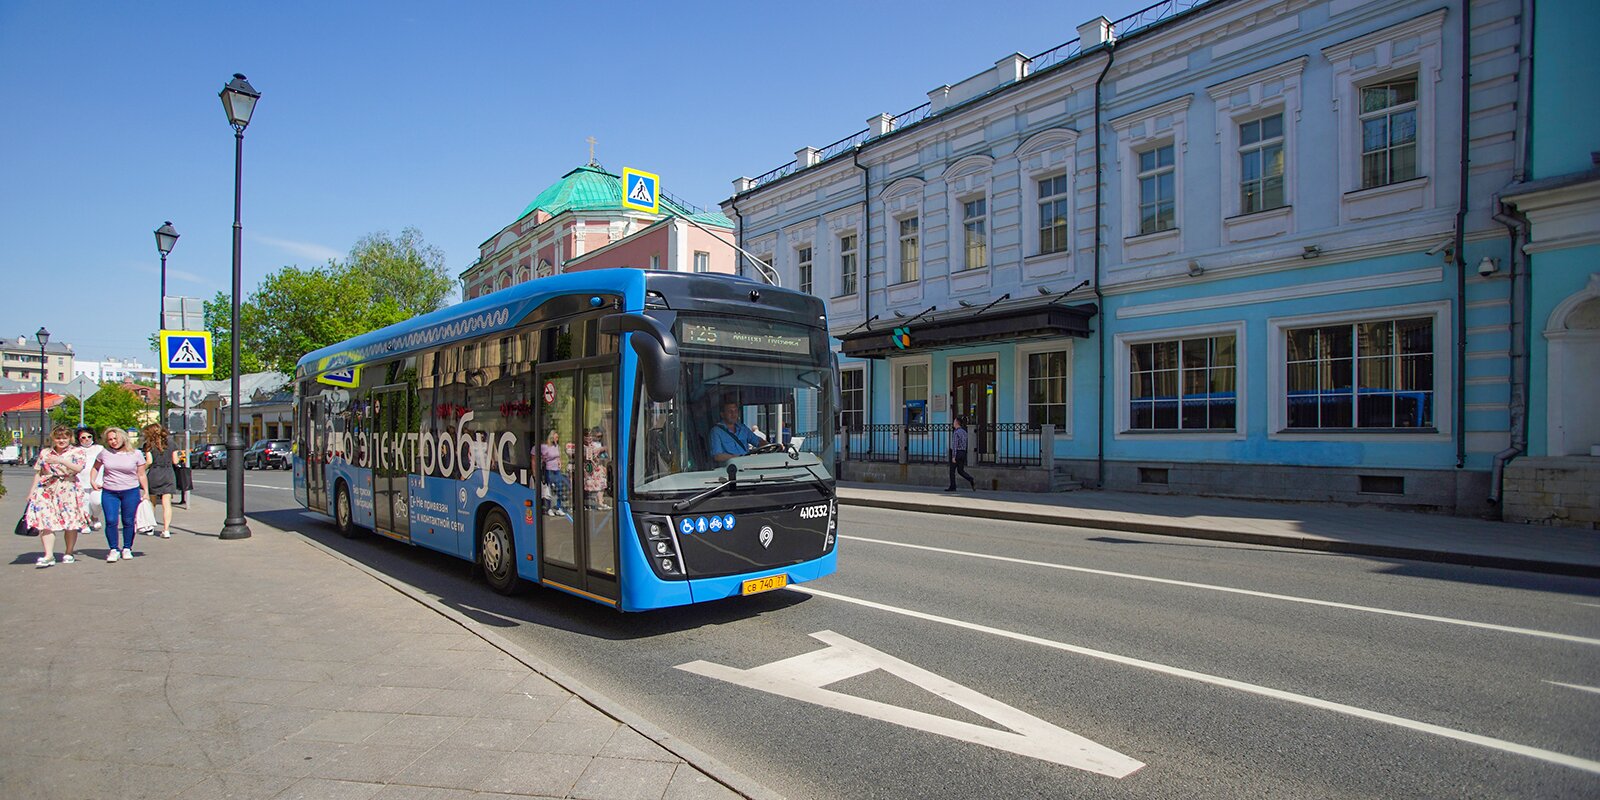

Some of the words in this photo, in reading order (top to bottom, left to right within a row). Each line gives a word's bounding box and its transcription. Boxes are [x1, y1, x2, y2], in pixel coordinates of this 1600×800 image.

[416, 496, 424, 507] Не
[423, 500, 449, 514] привязан
[800, 504, 828, 519] 410332
[420, 513, 451, 529] контактной
[450, 520, 465, 533] сети
[760, 578, 774, 590] 740
